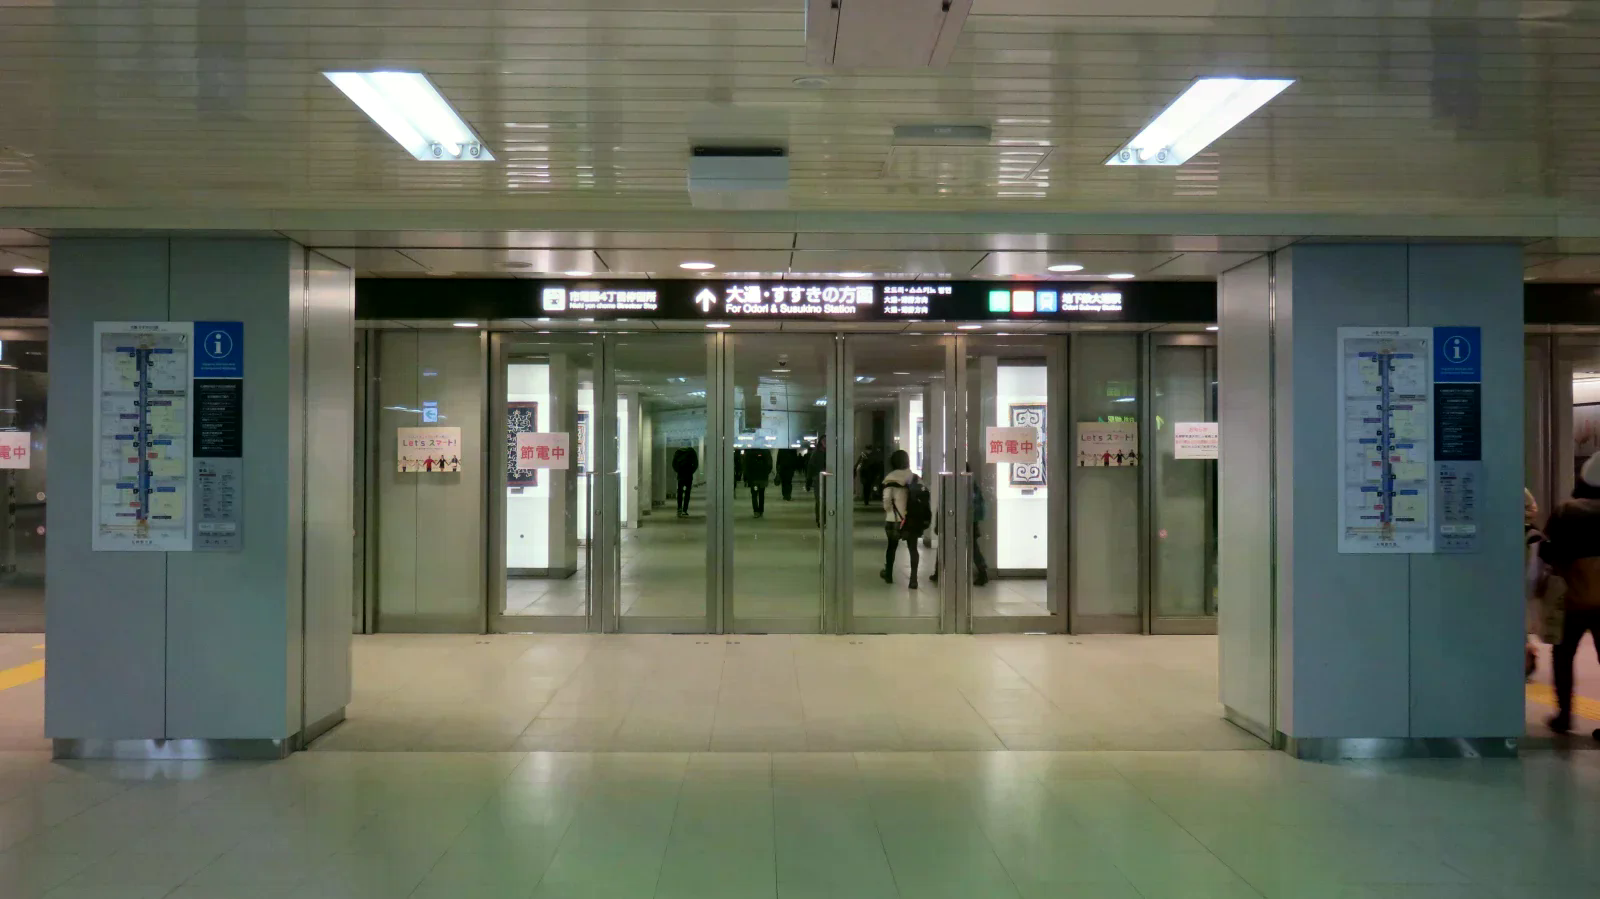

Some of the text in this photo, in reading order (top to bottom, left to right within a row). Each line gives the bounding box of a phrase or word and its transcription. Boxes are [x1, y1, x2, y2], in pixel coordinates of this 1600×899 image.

[725, 285, 874, 304] 大通・すすきの方面
[725, 304, 856, 314] For Odori & Susukino Station
[402, 439, 426, 447] Let's
[1081, 434, 1103, 442] Let's
[520, 445, 565, 461] 節電中
[989, 439, 1034, 455] 節電中
